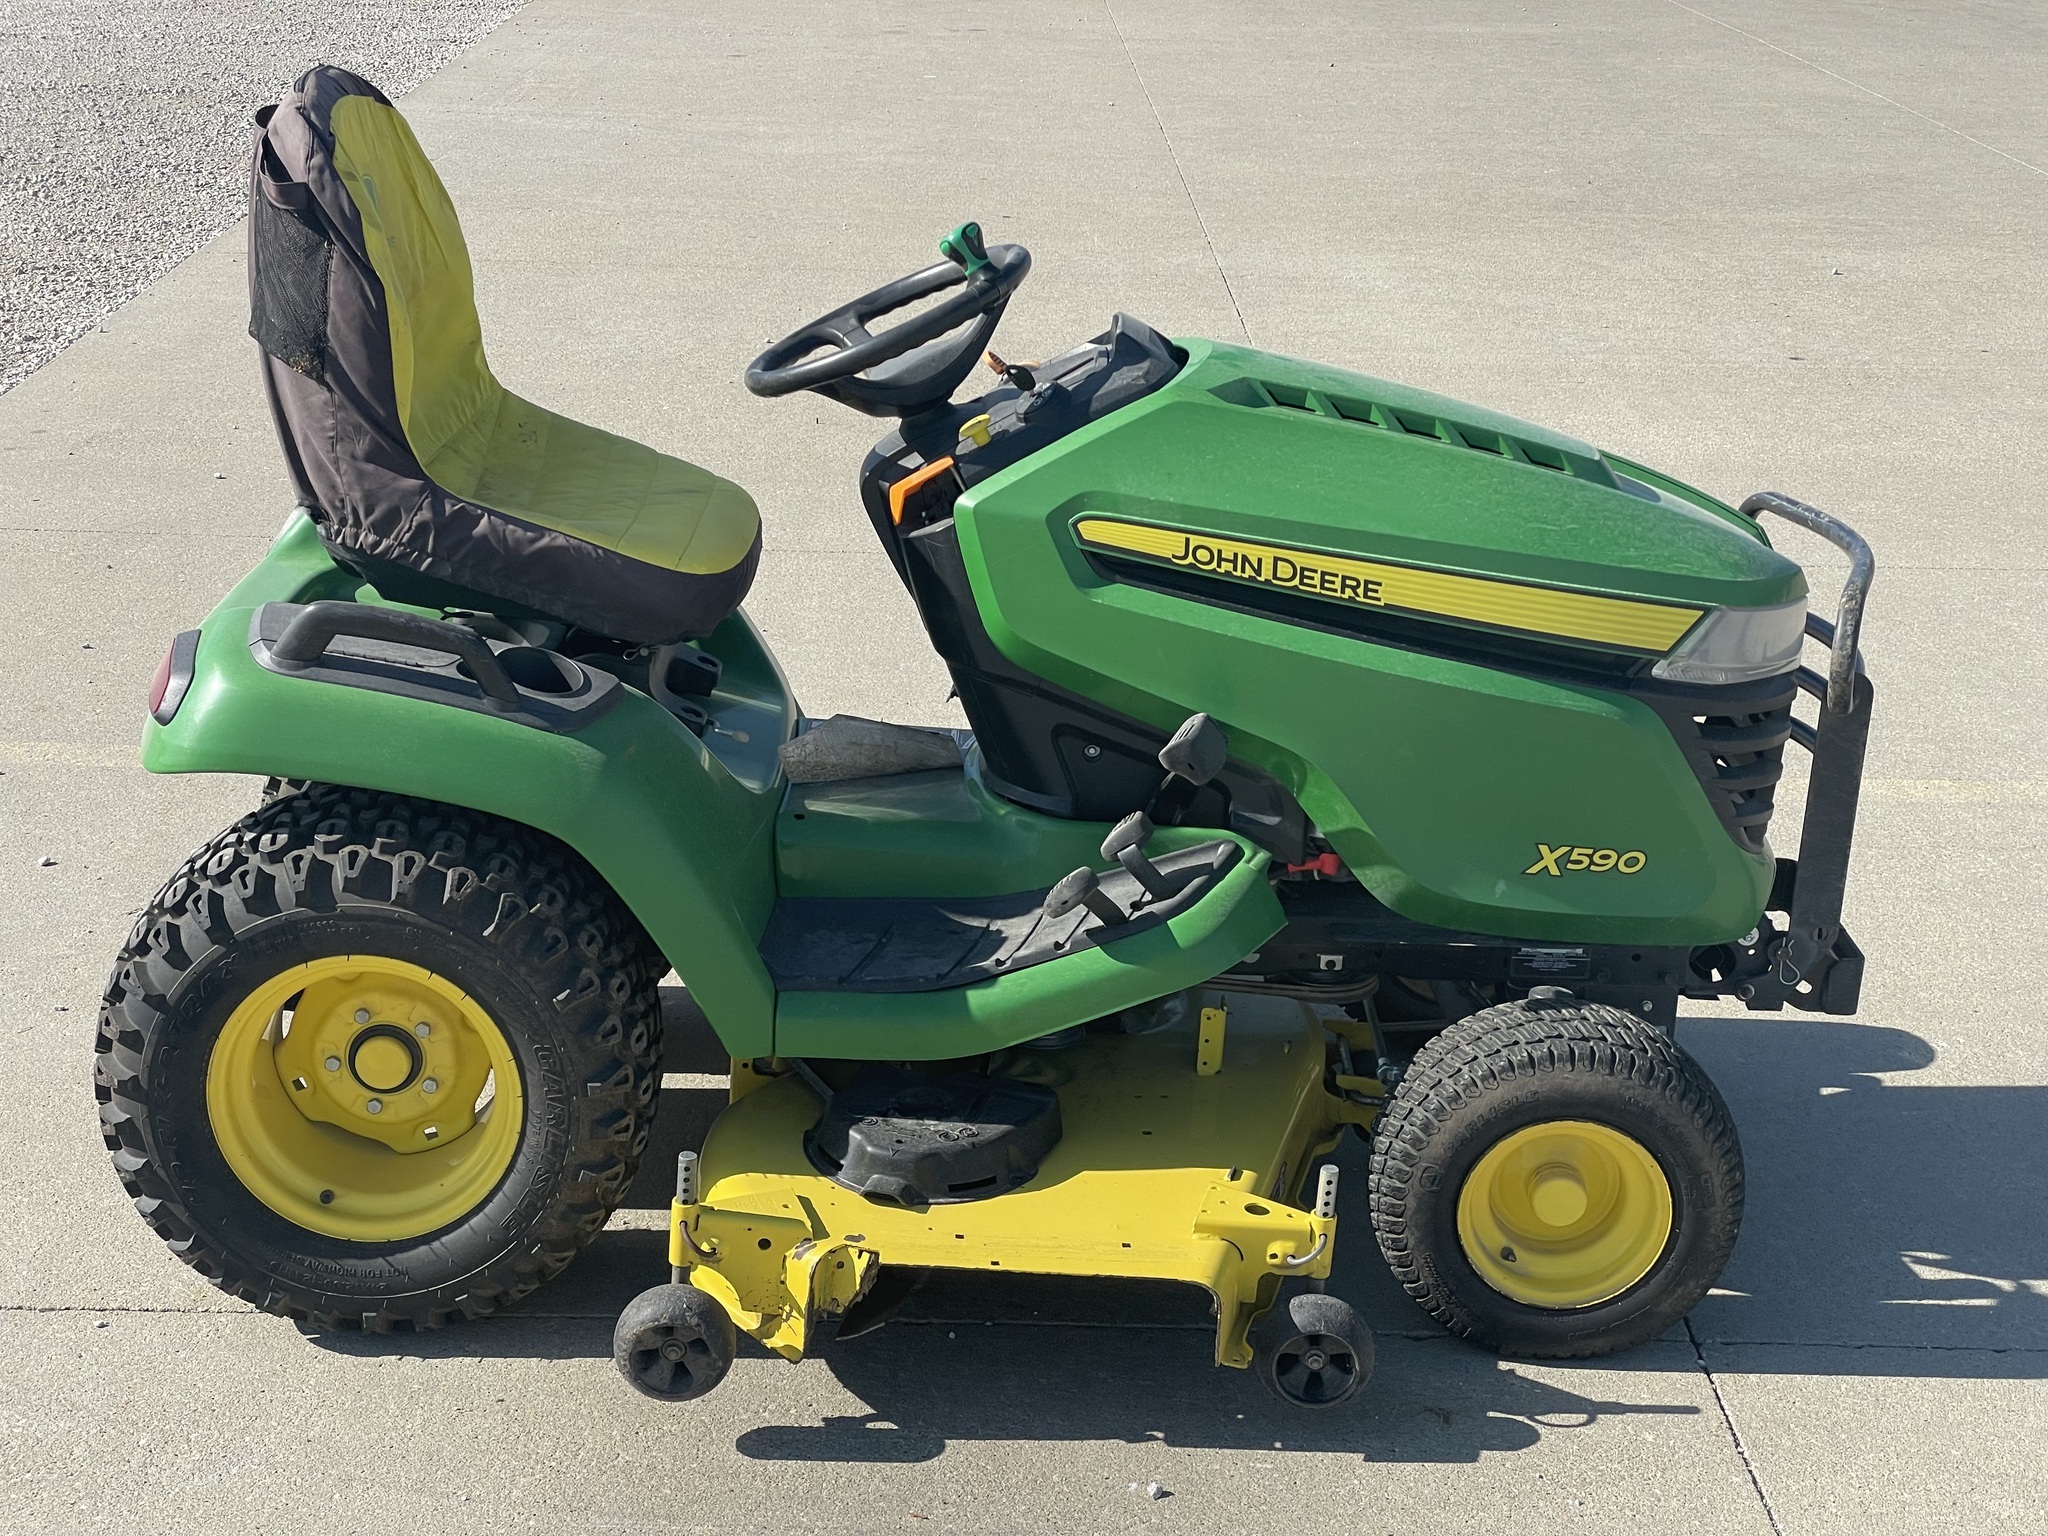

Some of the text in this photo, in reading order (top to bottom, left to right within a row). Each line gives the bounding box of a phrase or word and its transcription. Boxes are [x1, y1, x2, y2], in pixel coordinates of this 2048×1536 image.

[1171, 537, 1383, 604] JOHN DEERE
[1521, 842, 1648, 877] X590
[499, 1043, 567, 1238] CARLISLE
[1444, 1089, 1540, 1158] CARLISLE
[303, 1259, 358, 1278] HIGHWAY
[359, 1267, 383, 1279] FOR
